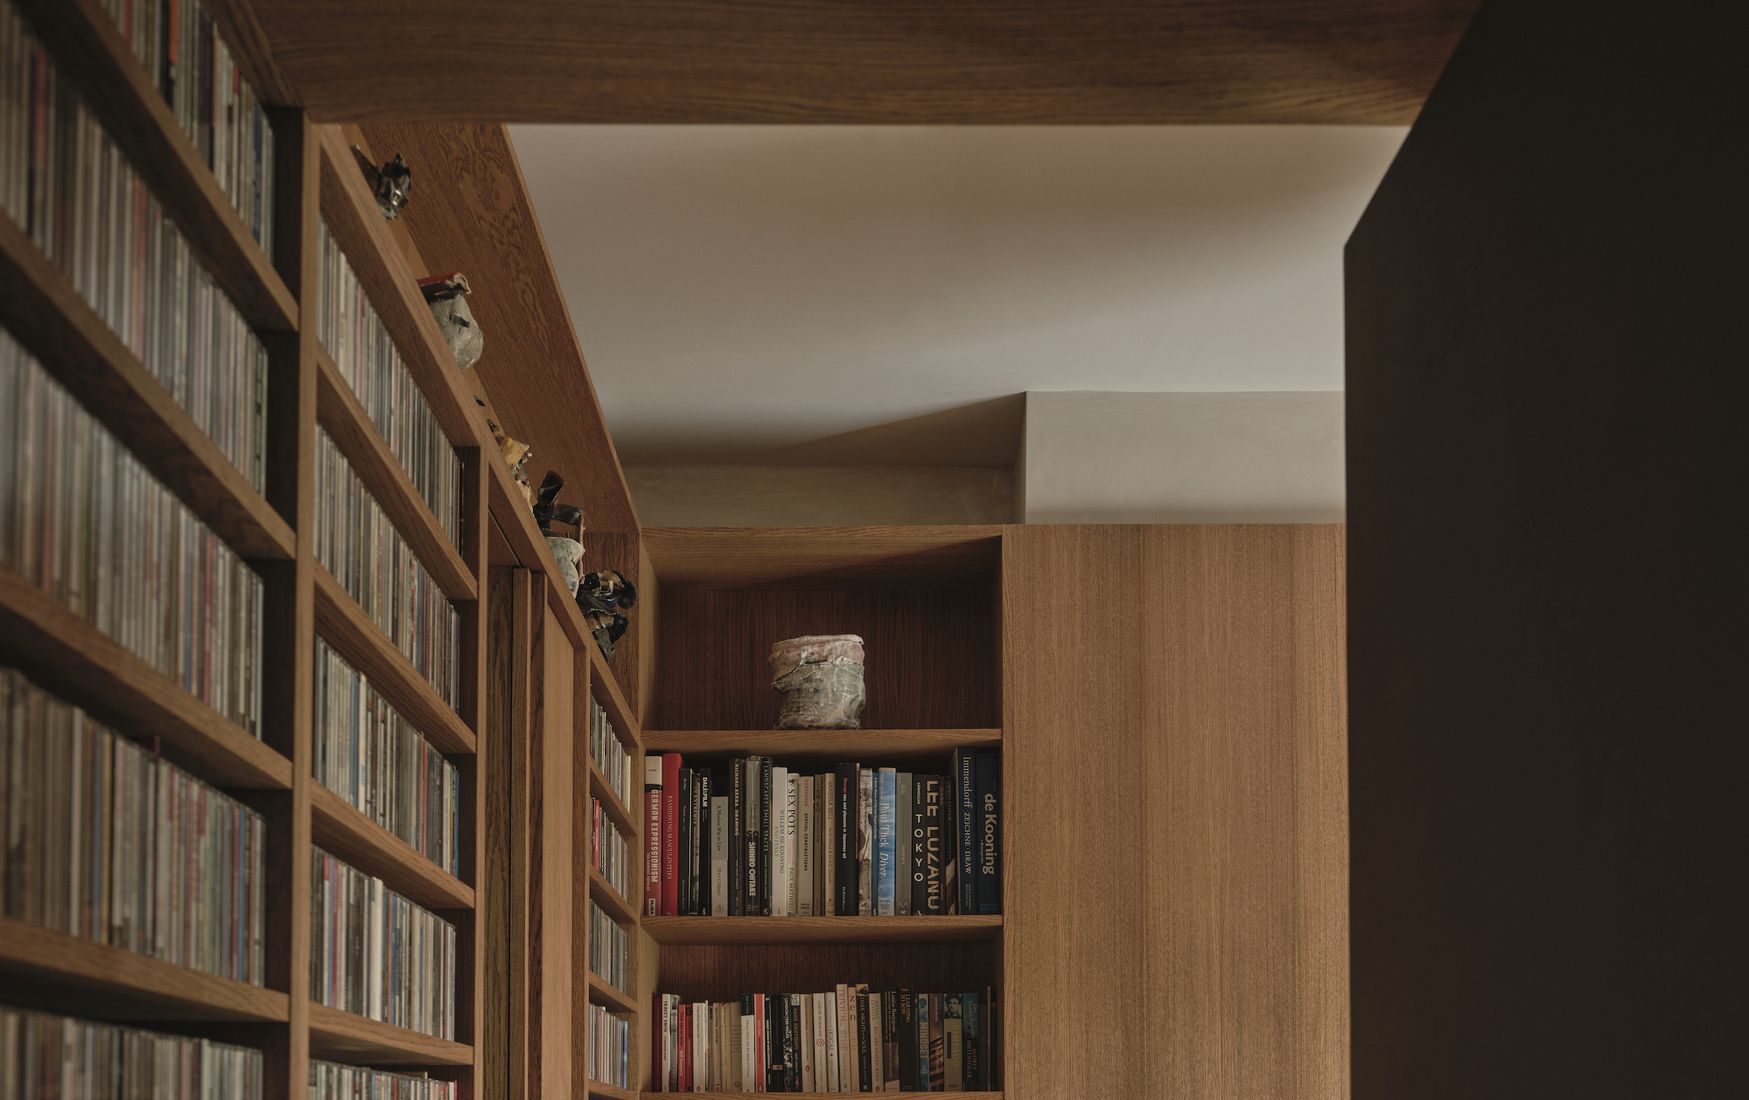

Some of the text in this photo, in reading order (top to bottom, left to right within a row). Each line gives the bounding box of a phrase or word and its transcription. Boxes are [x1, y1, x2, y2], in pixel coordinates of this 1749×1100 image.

[926, 780, 939, 817] LEE
[962, 756, 973, 809] Immendorff
[650, 789, 659, 883] GERMAN EXPRESSIONISM
[788, 789, 796, 836] SEX POTS
[880, 802, 889, 823] Paul
[880, 825, 889, 848] Thek
[982, 793, 997, 875] de Kooning
[748, 841, 756, 896] SHINRO OHTAKE
[914, 814, 924, 882] TOKYO
[919, 1022, 928, 1059] MINDSET
